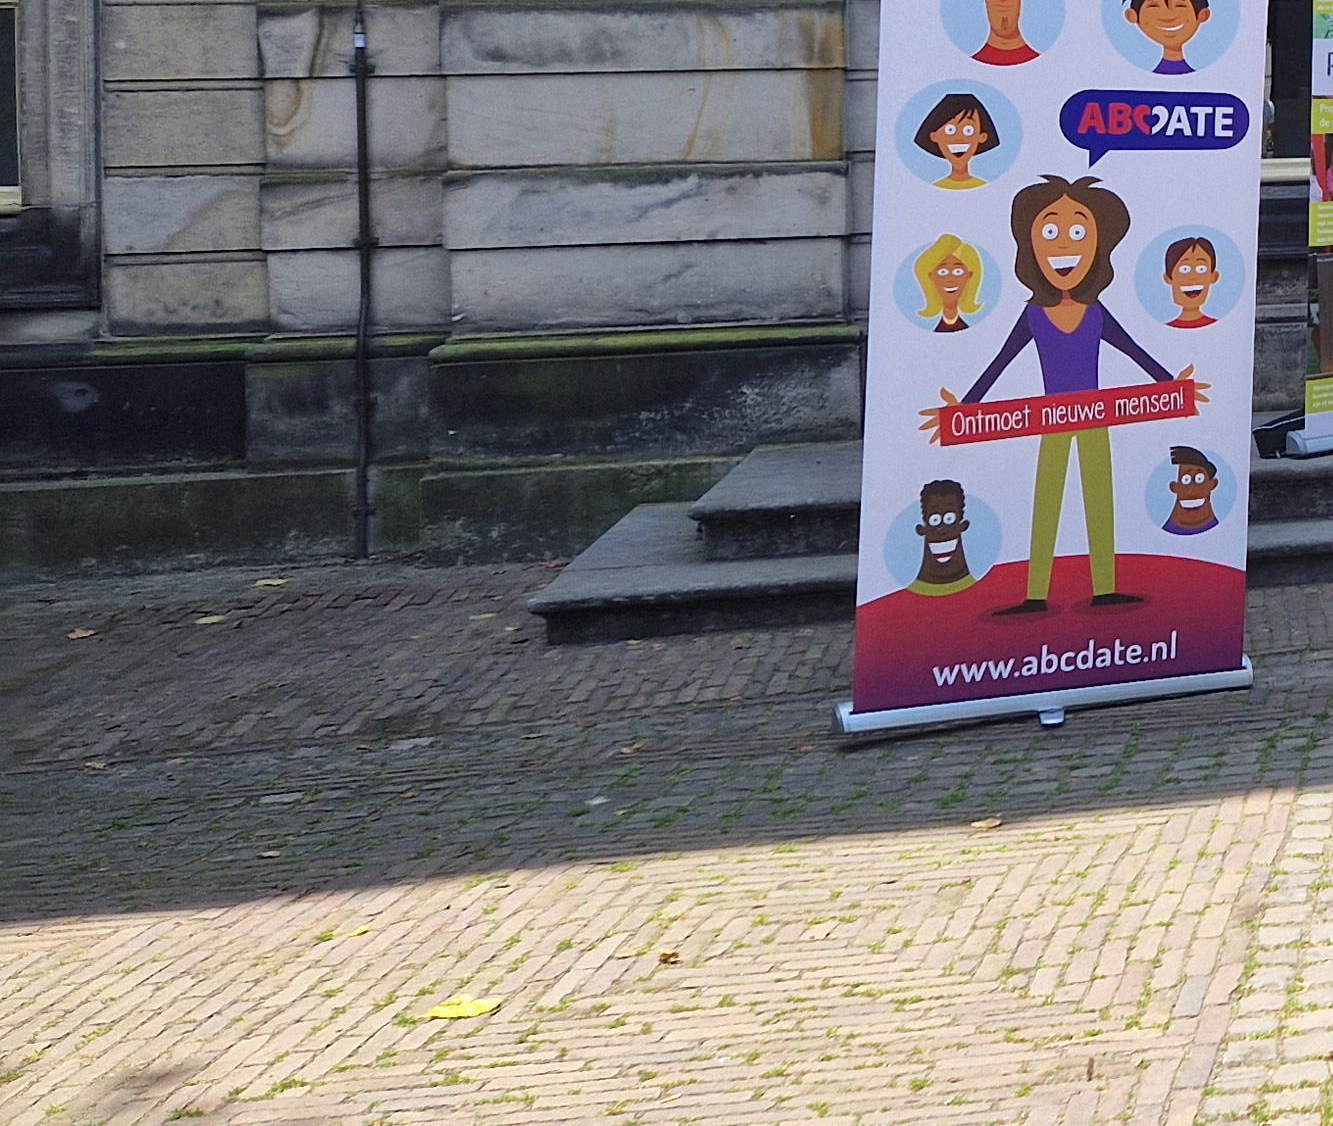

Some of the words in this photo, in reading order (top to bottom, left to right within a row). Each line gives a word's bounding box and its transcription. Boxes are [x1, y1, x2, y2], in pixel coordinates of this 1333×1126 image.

[1319, 118, 1330, 128] de
[951, 404, 1032, 436] Ontmoet
[1041, 399, 1106, 426] nieuwe
[1115, 386, 1185, 418] mensen!
[932, 629, 1178, 687] www.abcdate.nl
